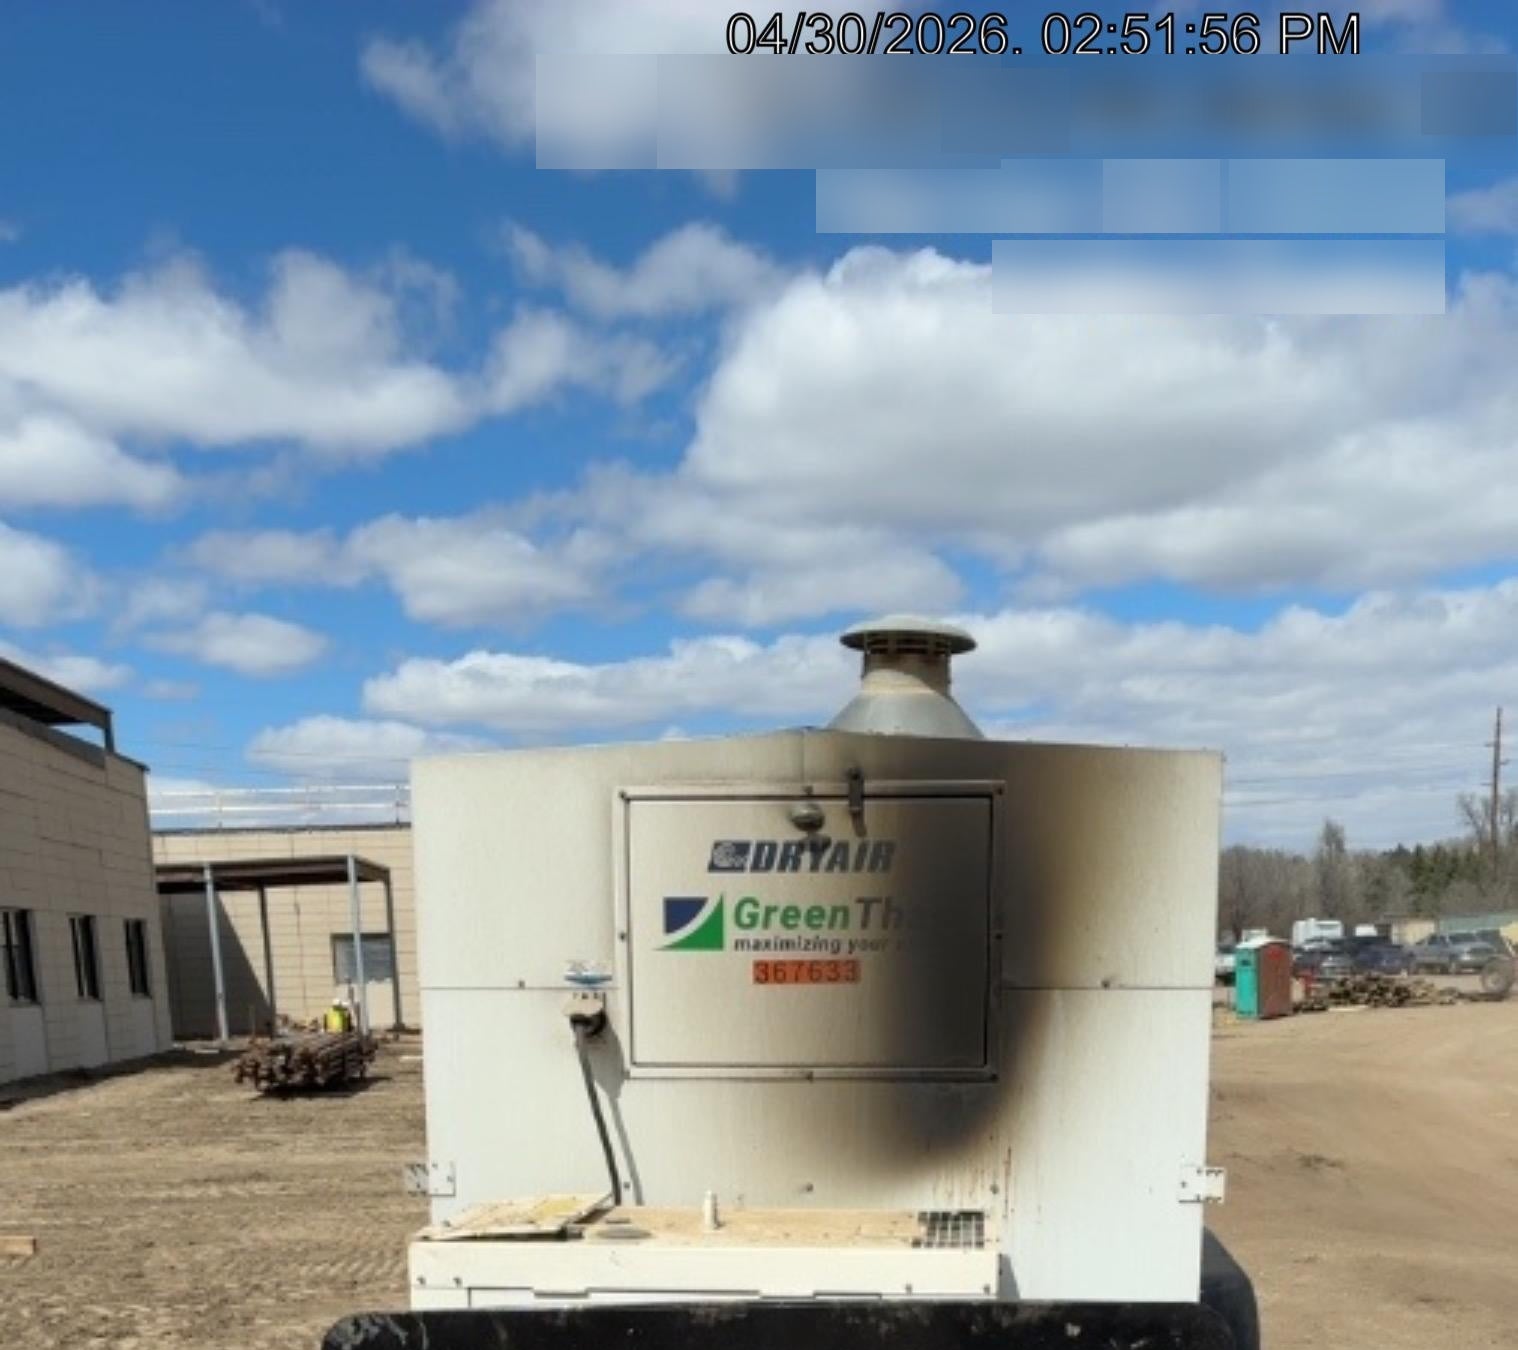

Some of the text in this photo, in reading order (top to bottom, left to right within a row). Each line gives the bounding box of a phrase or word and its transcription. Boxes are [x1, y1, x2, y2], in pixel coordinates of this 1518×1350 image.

[748, 840, 897, 873] DRYAIR
[733, 897, 905, 931] GreenTh
[733, 935, 841, 955] maximizing
[755, 960, 860, 984] 367633
